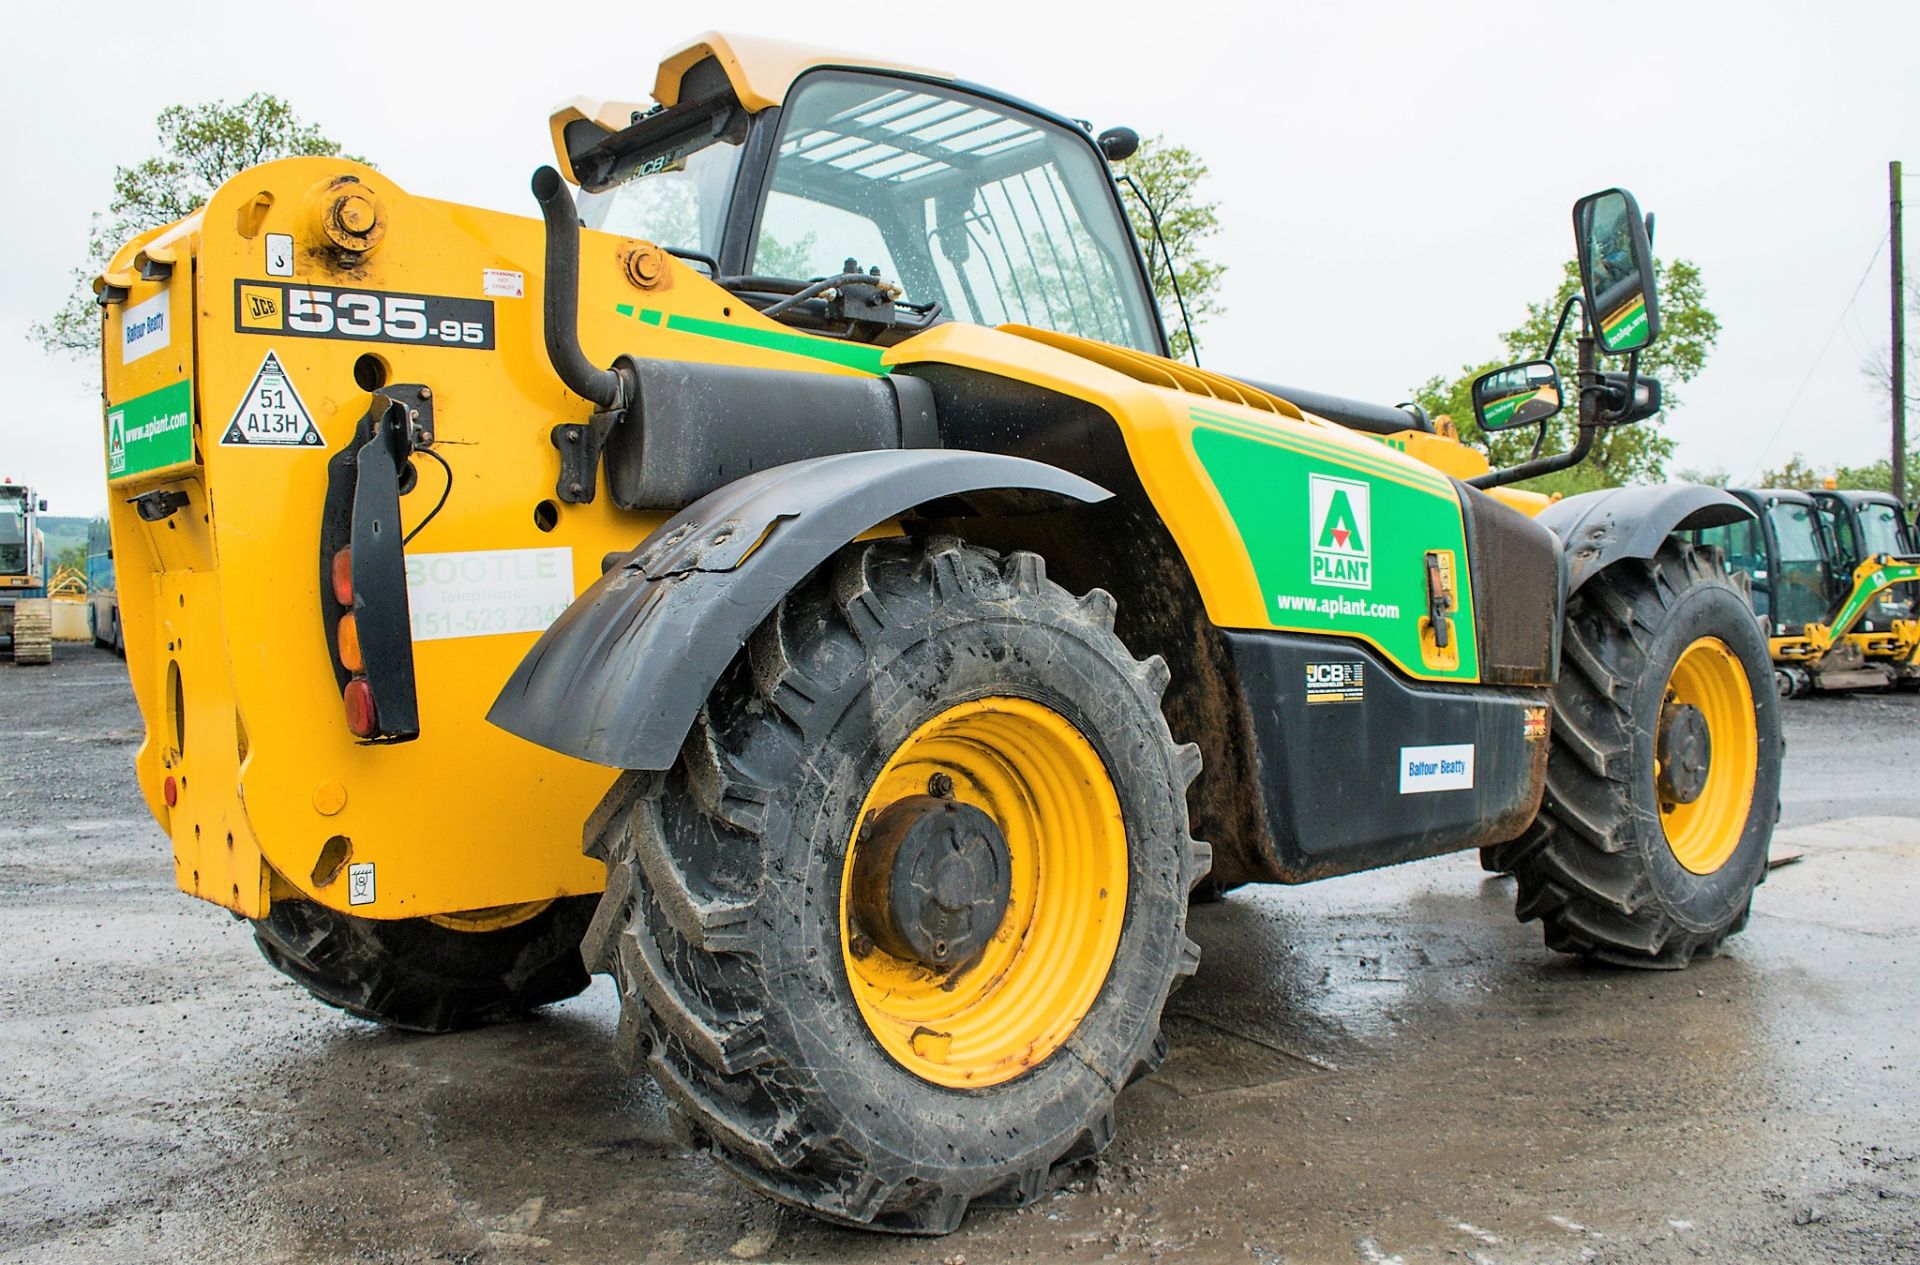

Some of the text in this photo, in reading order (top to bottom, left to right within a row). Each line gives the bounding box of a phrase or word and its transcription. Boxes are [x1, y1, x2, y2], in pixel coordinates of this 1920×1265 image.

[633, 156, 665, 178] JCB
[126, 312, 164, 344] Balfour Beatty
[251, 288, 484, 343] JCB 535-95
[260, 389, 286, 409] 51
[111, 418, 124, 453] A
[126, 411, 188, 443] www.aplant.com
[247, 413, 298, 434] AI3H
[1318, 489, 1365, 552] A
[405, 553, 556, 587] BOOTLE
[1313, 556, 1369, 583] PLANT
[1277, 595, 1400, 619] www.aplant.com
[1306, 664, 1345, 683] JCB
[1409, 760, 1466, 777] Balfour Beatty
